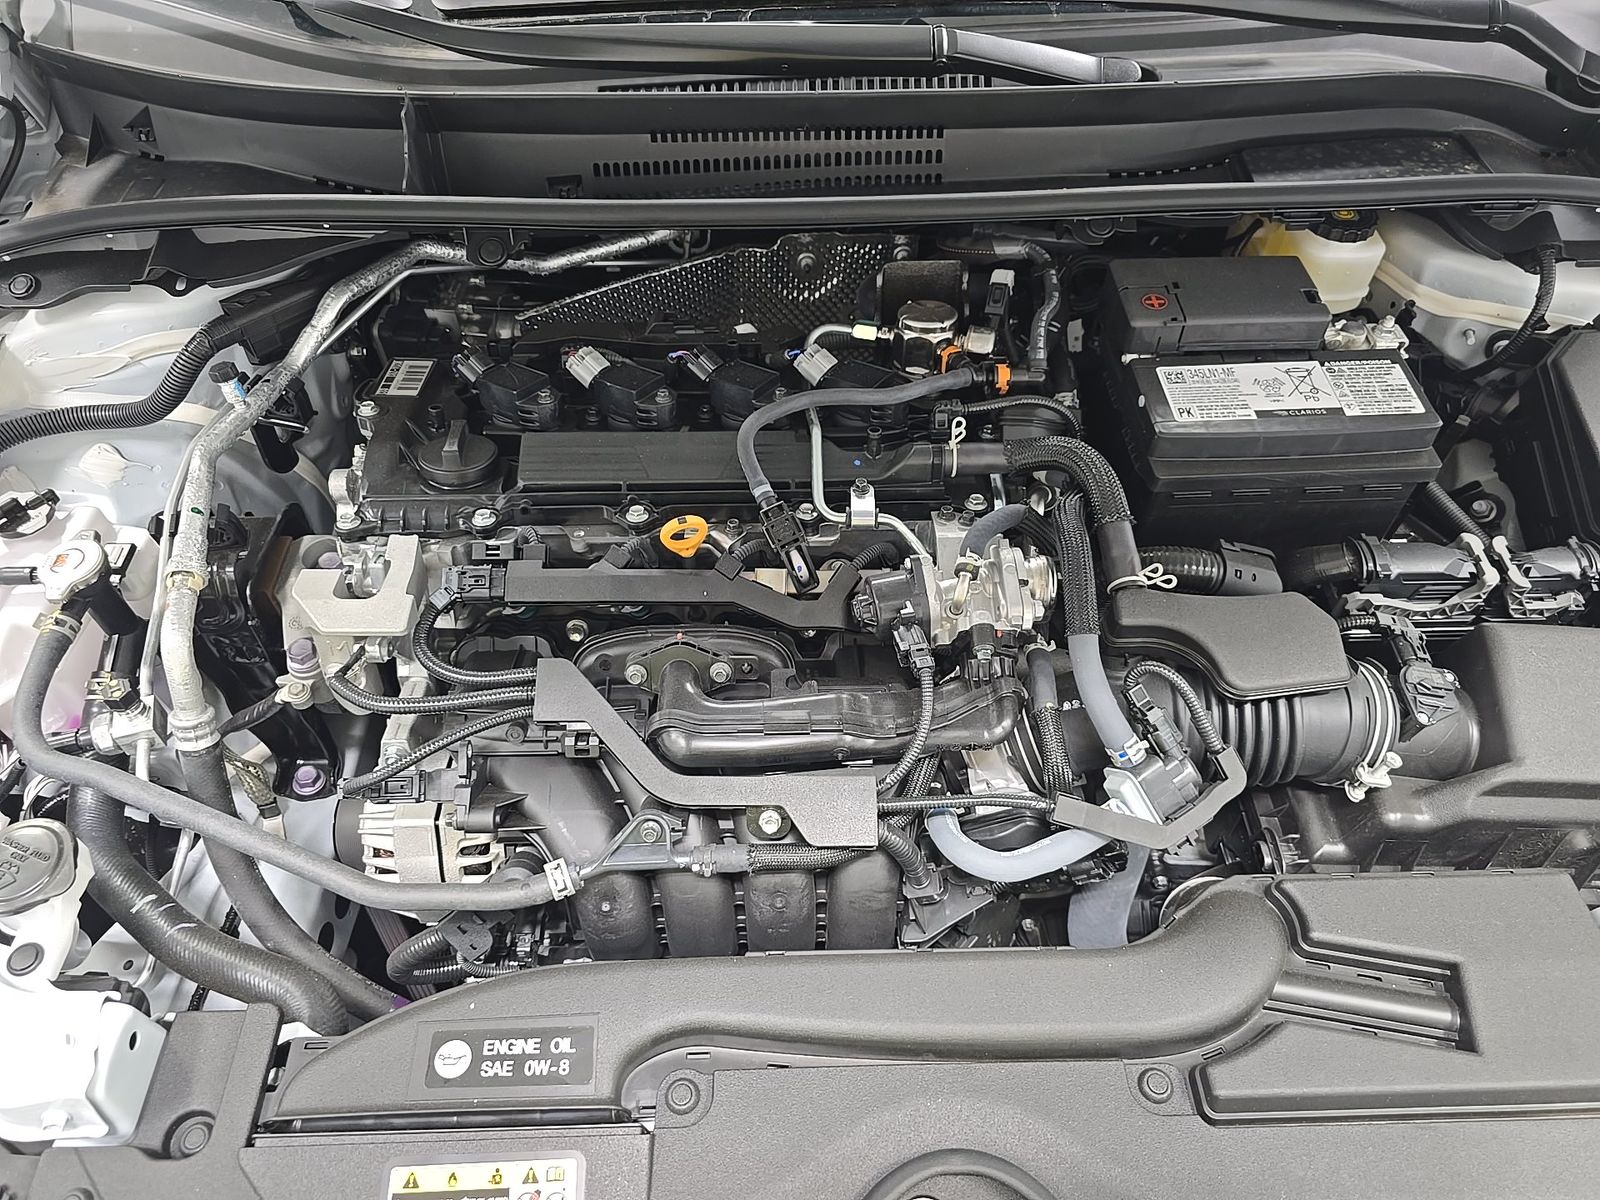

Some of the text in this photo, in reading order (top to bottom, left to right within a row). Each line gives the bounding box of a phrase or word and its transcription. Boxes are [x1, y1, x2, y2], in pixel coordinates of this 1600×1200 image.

[1303, 394, 1321, 402] Pb
[1177, 407, 1195, 418] PK
[1288, 409, 1328, 417] CLARIOS
[482, 1037, 576, 1056] ENGINE OIL
[480, 1058, 570, 1077] SAE 0W-8
